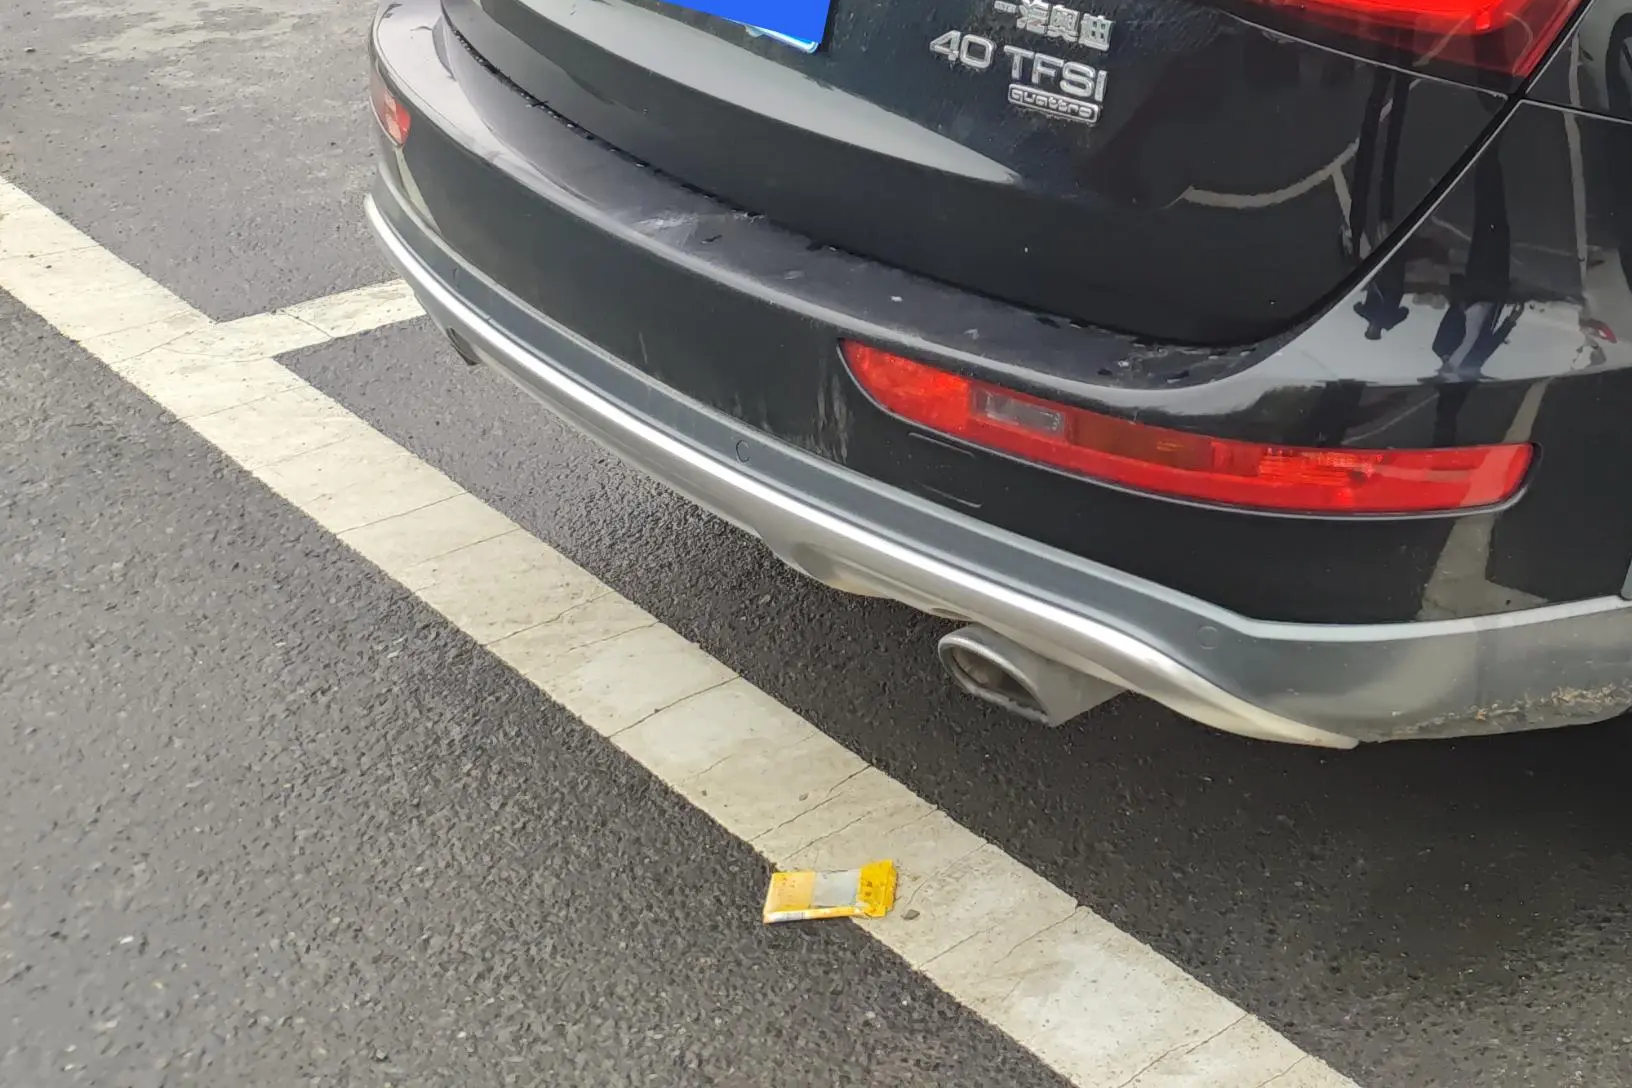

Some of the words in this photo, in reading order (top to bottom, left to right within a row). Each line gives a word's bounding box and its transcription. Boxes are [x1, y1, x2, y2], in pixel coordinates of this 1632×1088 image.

[929, 29, 995, 69] 40
[1003, 44, 1108, 102] TFSI
[1010, 87, 1094, 119] quattro
